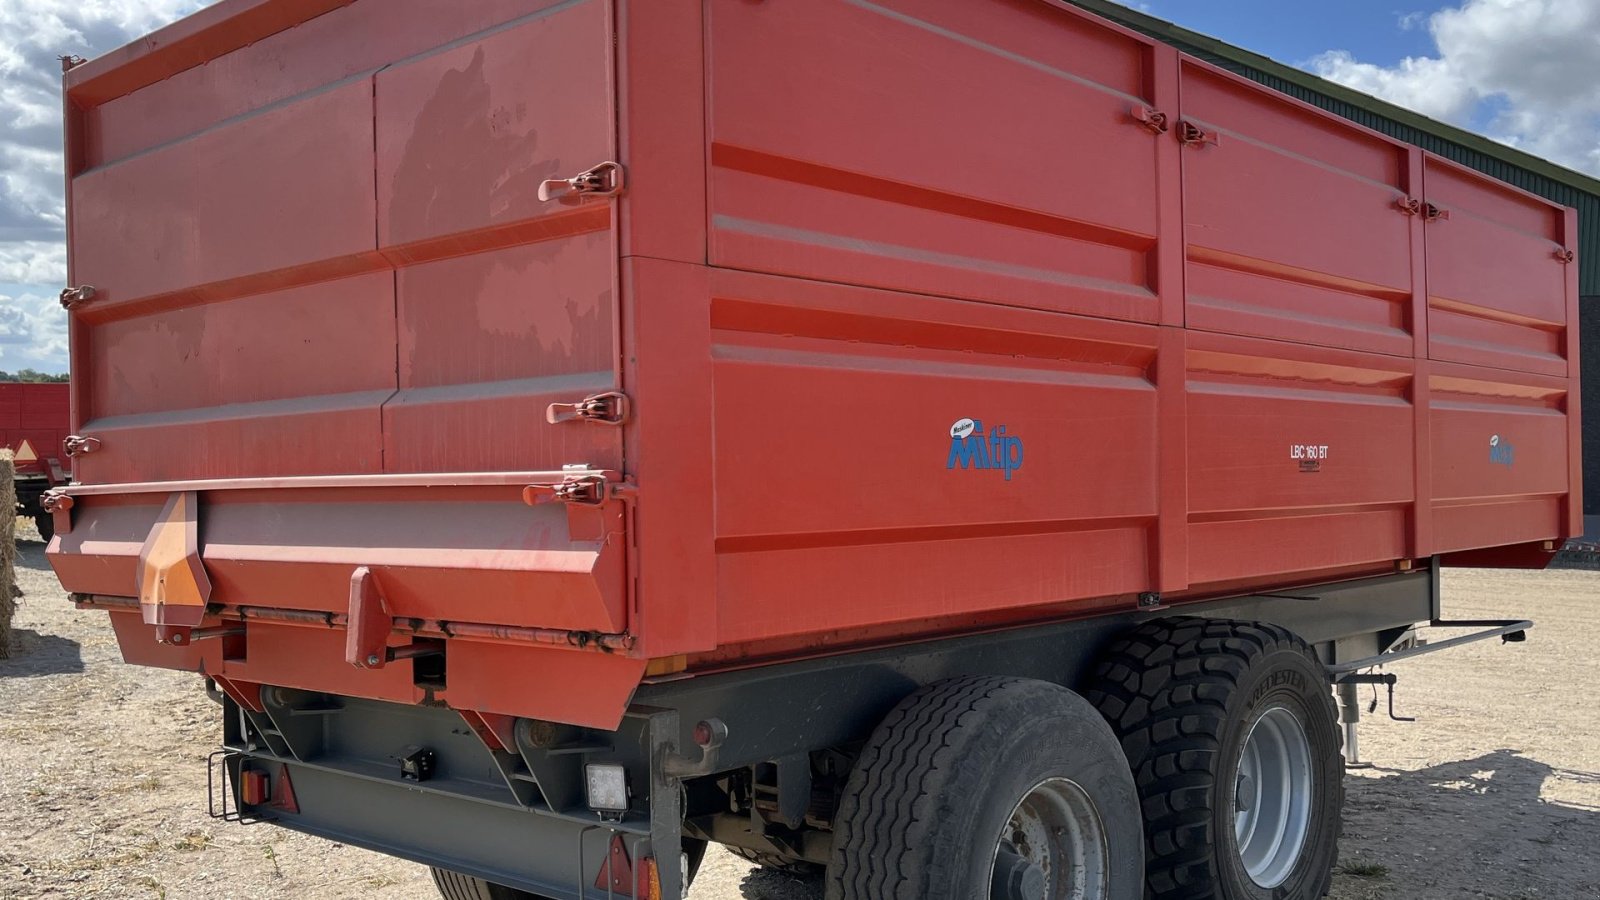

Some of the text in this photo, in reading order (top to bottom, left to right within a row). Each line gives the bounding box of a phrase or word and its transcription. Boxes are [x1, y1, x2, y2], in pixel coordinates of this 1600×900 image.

[1290, 445, 1329, 459] LBC 160 BT
